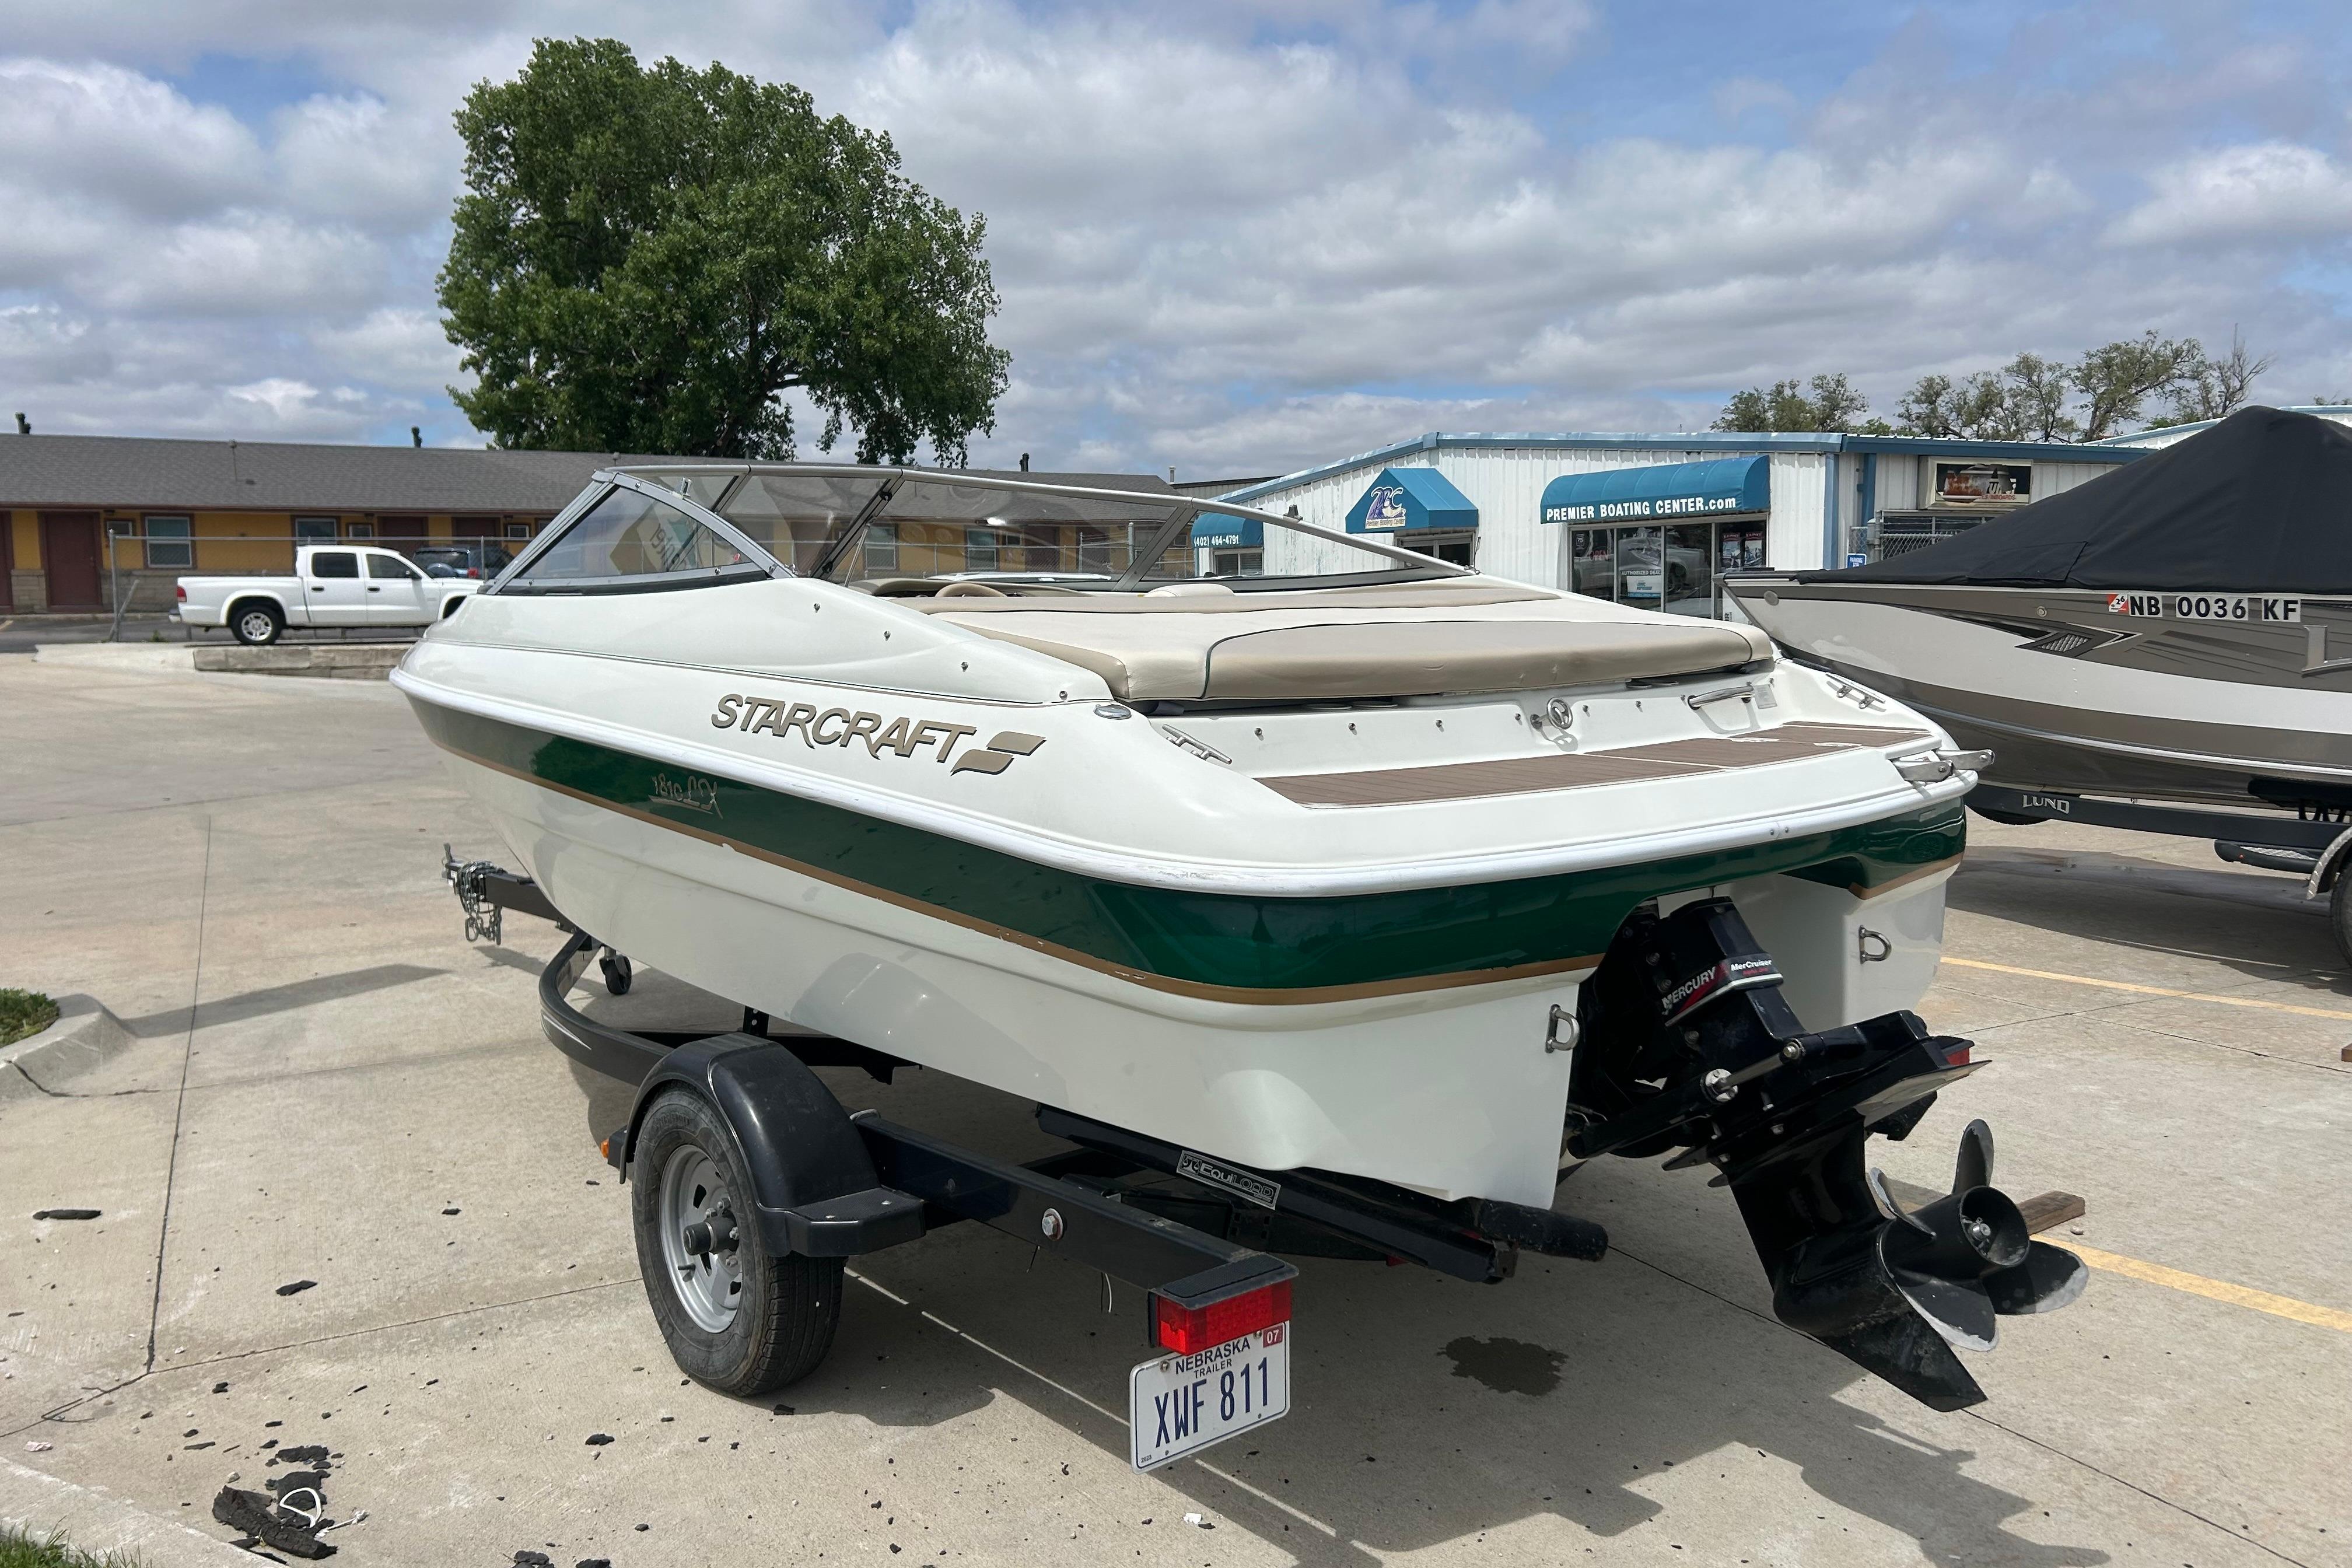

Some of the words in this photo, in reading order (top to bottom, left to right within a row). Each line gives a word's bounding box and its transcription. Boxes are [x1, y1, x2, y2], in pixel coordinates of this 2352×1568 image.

[1546, 505, 1595, 521] PREMIER
[1600, 502, 1650, 517] BOATING
[1656, 497, 1736, 514] CENTER.com
[1194, 536, 1209, 547] (402)
[1212, 534, 1239, 545] 464-4791
[2130, 596, 2161, 615] NB
[2177, 596, 2246, 619] 0036
[2264, 599, 2299, 621] KF
[711, 694, 977, 763] STARCRAFT
[2022, 794, 2070, 814] LUND
[1731, 960, 1772, 971] MerCruiser
[1662, 966, 1717, 1010] MERCURY
[1266, 1329, 1279, 1343] 07
[1175, 1337, 1251, 1374] NEBRASKA
[1194, 1359, 1232, 1378] TRAILER
[1154, 1378, 1207, 1448] XWF
[1220, 1357, 1268, 1421] 811
